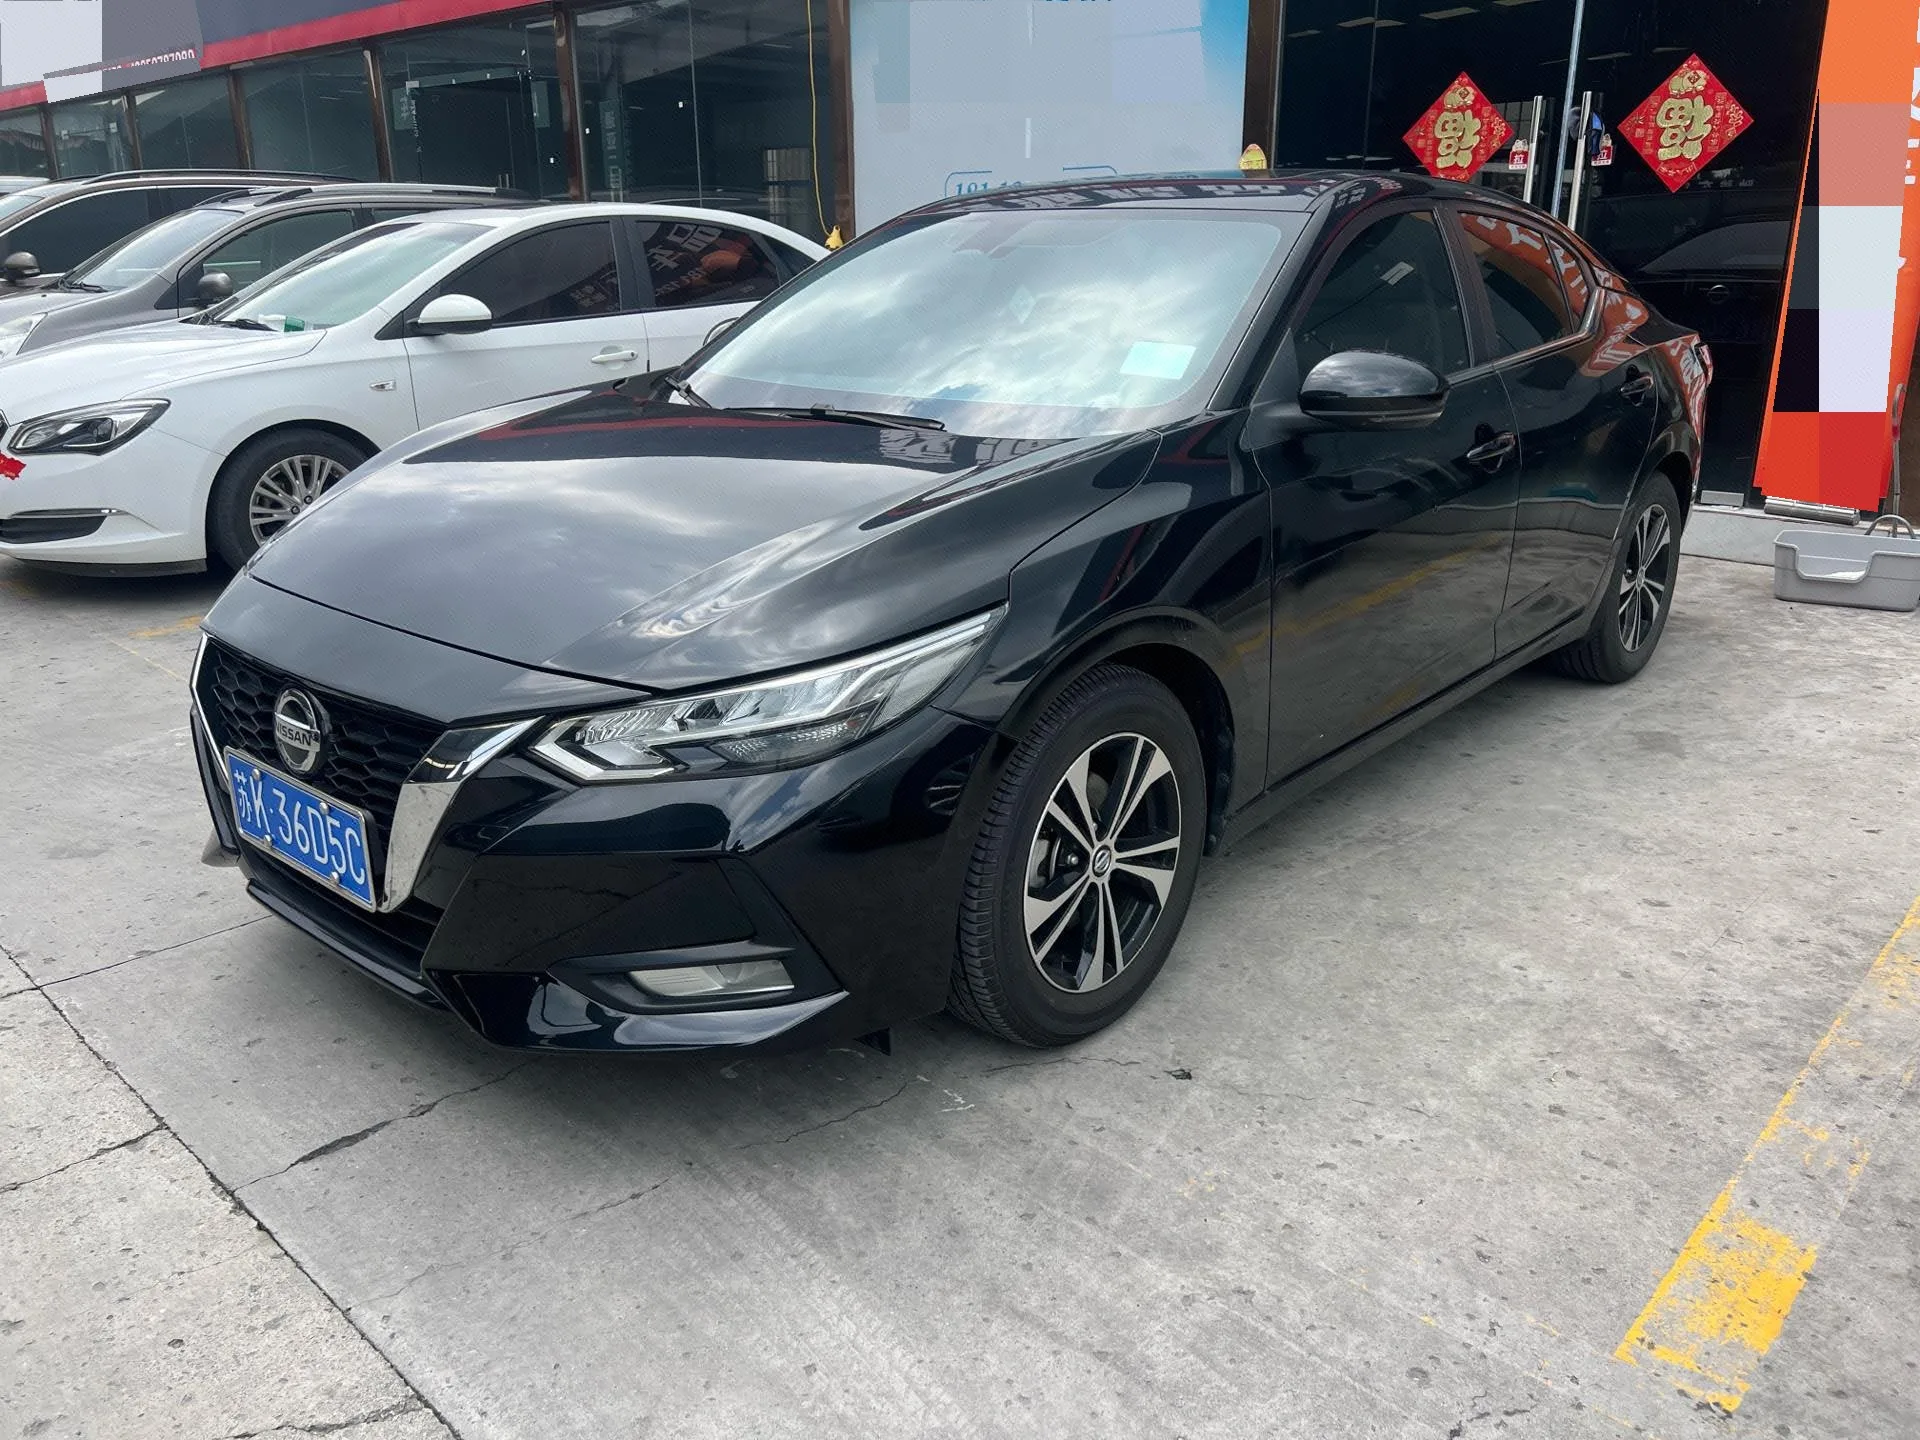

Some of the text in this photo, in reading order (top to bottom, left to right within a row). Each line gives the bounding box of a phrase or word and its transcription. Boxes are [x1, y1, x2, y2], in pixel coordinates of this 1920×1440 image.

[1435, 110, 1481, 169] 福
[1656, 96, 1714, 161] 福
[275, 721, 312, 746] NISSAN
